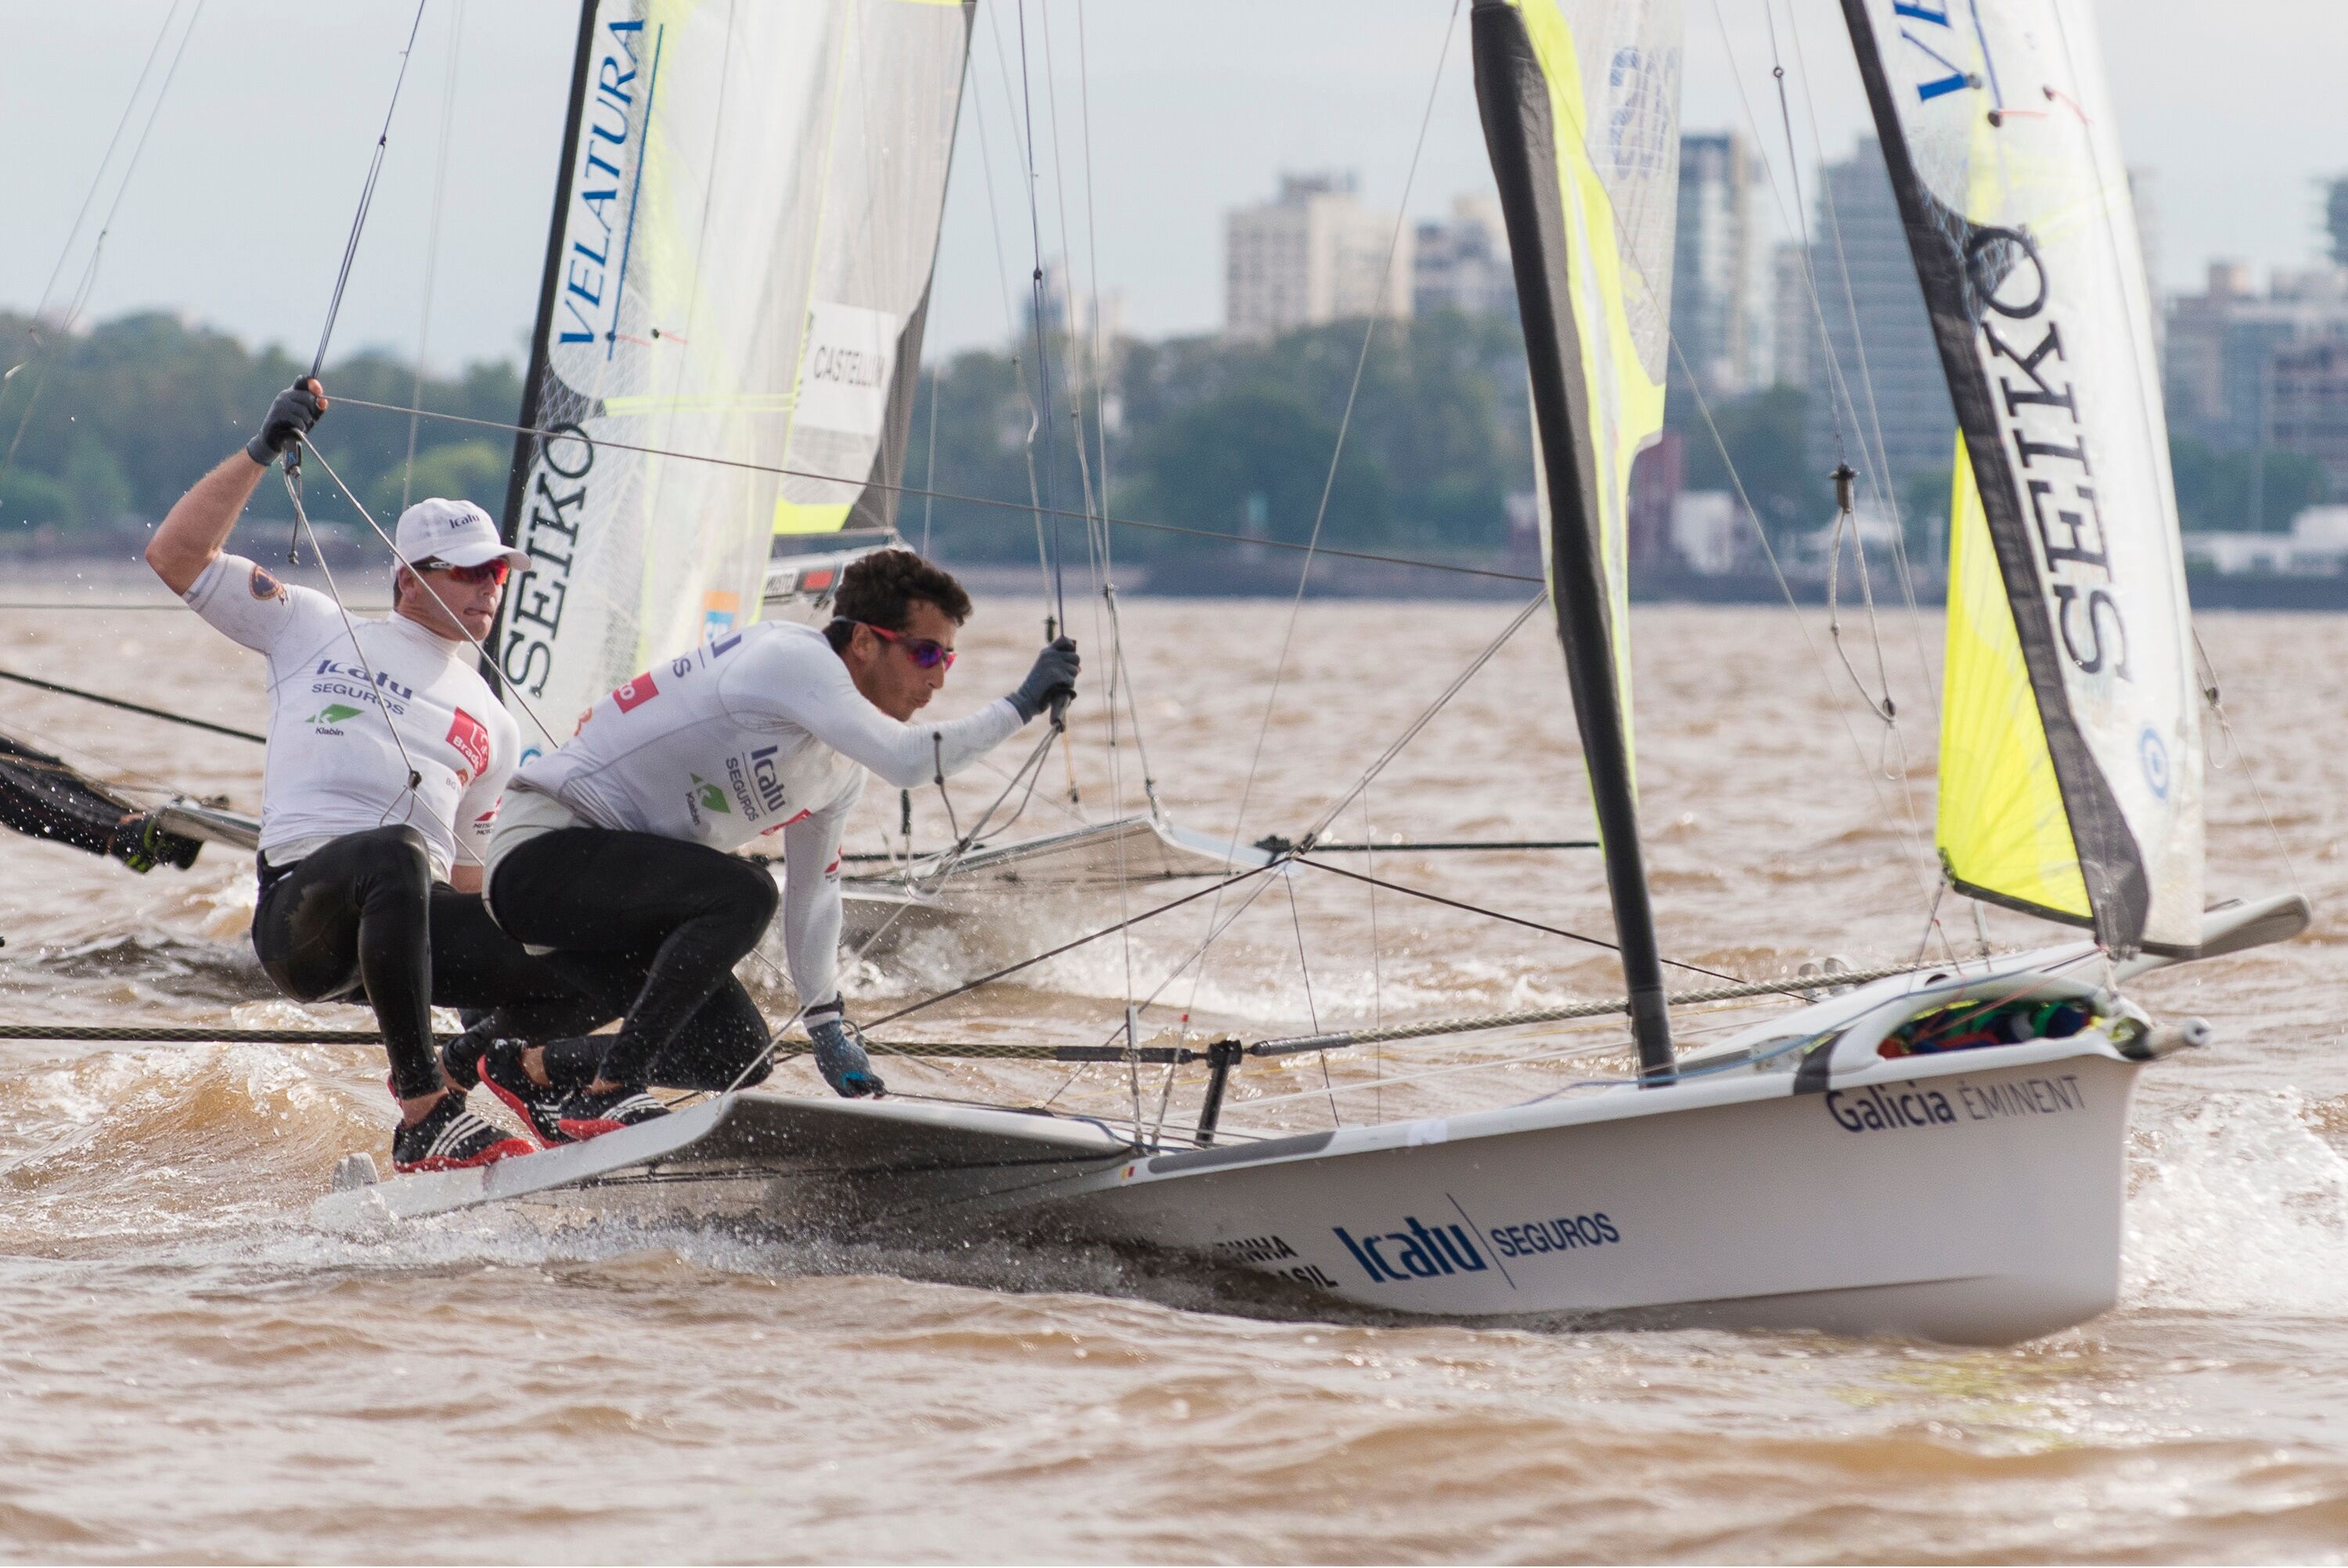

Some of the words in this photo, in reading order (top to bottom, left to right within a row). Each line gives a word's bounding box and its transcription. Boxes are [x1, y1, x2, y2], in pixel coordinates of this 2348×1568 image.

[560, 19, 644, 344] VELATURA
[1964, 227, 2134, 683] SEIKO
[448, 513, 480, 529] Icatu
[503, 422, 595, 698] SEIKO
[312, 683, 405, 715] SEGUROS
[316, 659, 413, 699] Icatu
[315, 727, 344, 736] Klabin
[726, 757, 759, 822] SEGUROS
[751, 745, 786, 812] Icatu
[1826, 1078, 1956, 1132] Galicia
[1332, 1216, 1488, 1283] Icatu
[1490, 1212, 1620, 1257] SEGUROS
